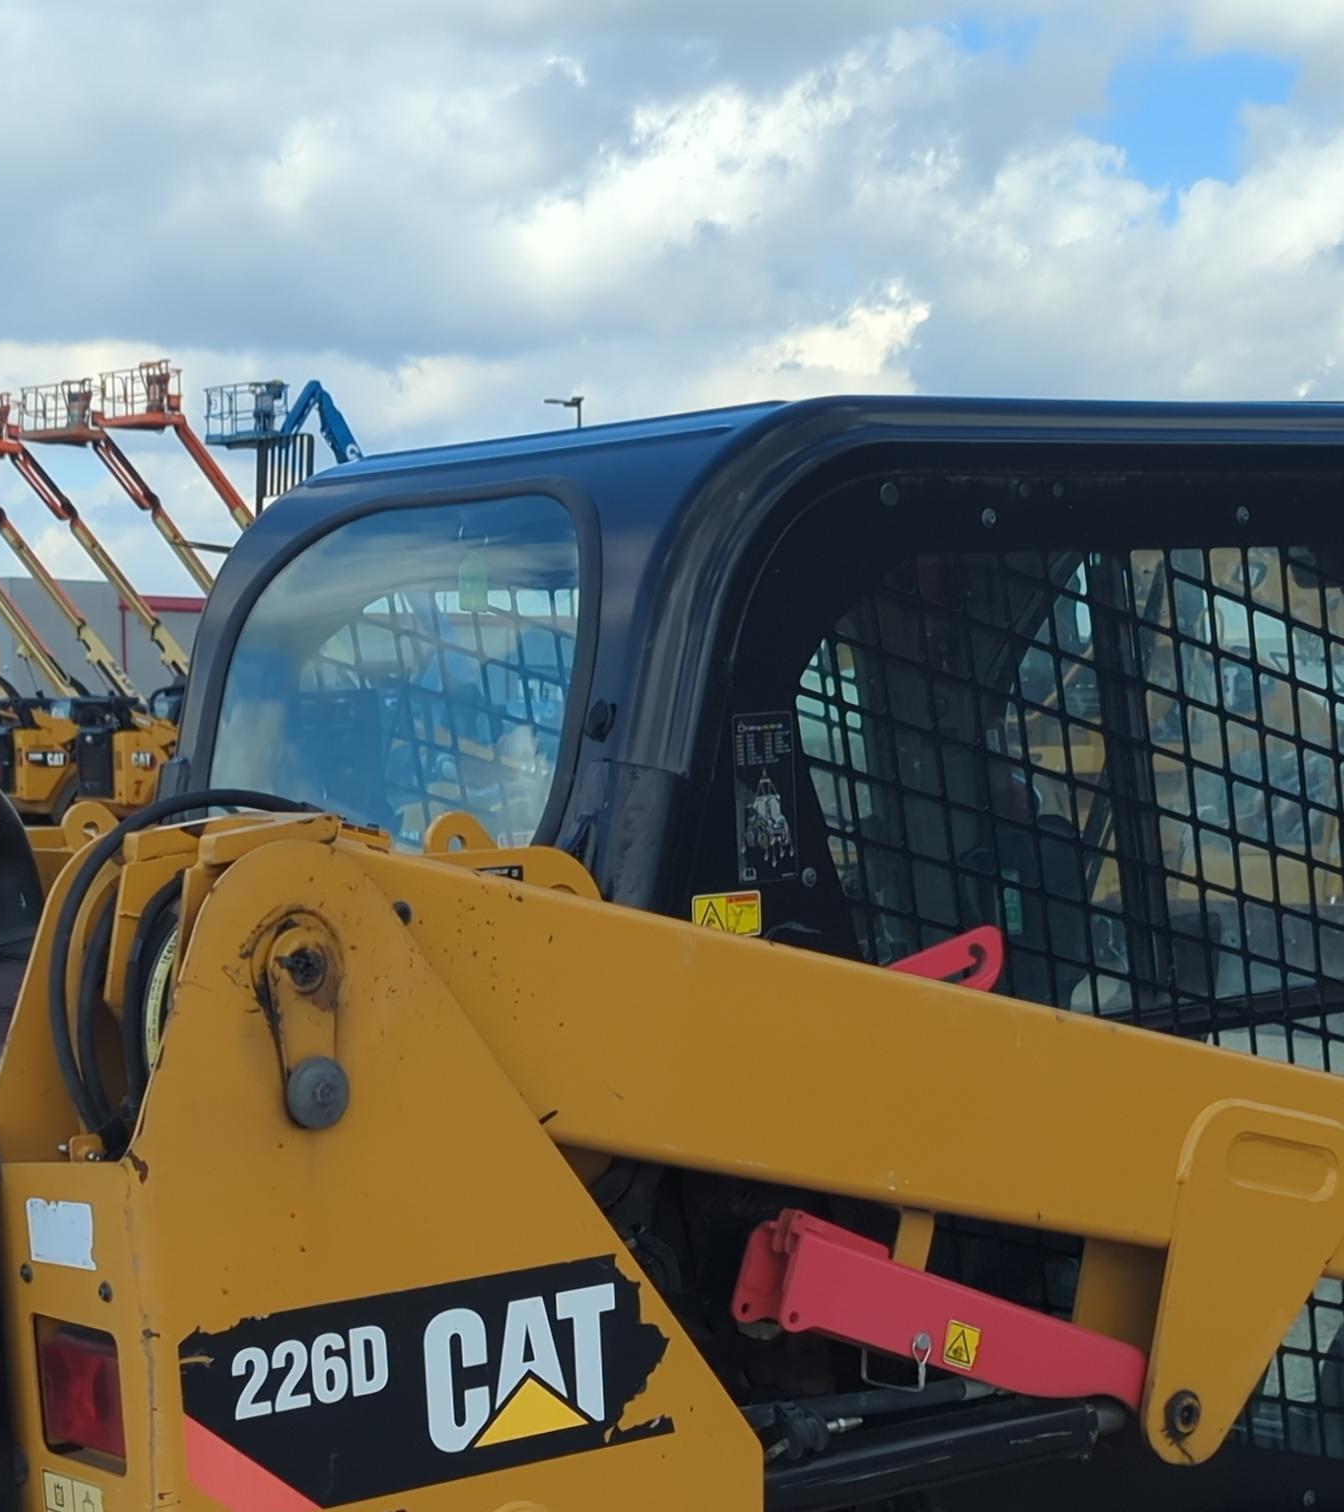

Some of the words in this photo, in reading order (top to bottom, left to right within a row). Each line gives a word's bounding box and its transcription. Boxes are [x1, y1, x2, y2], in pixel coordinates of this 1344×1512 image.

[46, 752, 65, 766] CAT
[131, 752, 152, 767] CAT
[231, 1326, 389, 1421] 226D
[422, 1282, 616, 1453] CAT
